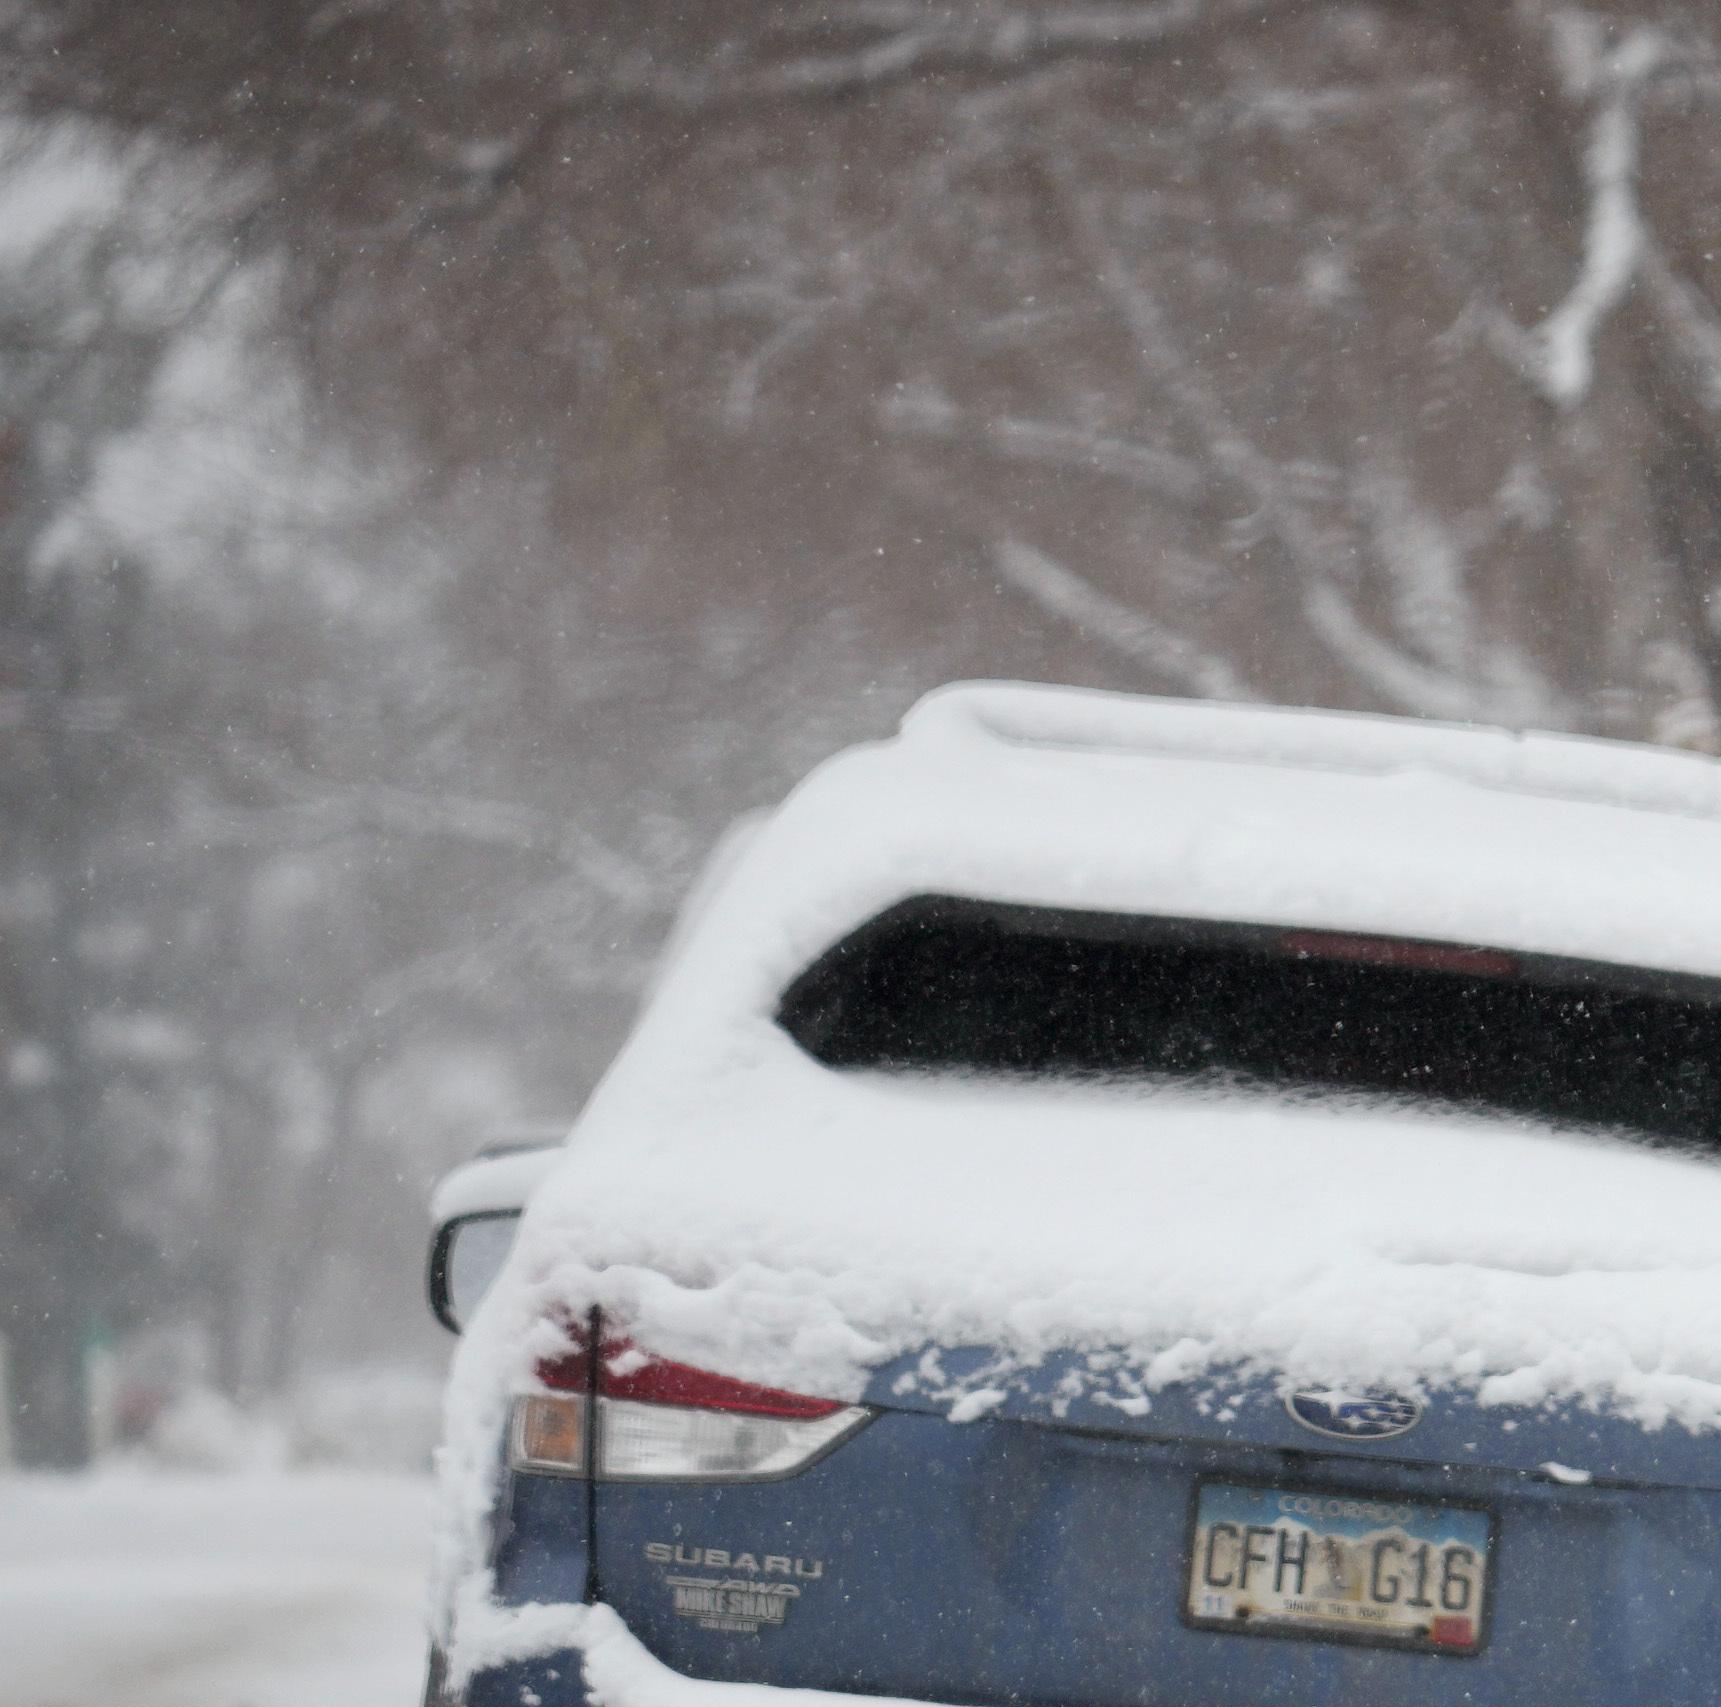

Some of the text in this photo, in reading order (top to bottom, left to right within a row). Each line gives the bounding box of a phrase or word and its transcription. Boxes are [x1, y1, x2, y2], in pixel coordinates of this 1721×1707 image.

[1278, 1495, 1414, 1524] COLORADO
[645, 1542, 824, 1579] SUBARU
[1203, 1522, 1475, 1610] CFH G16
